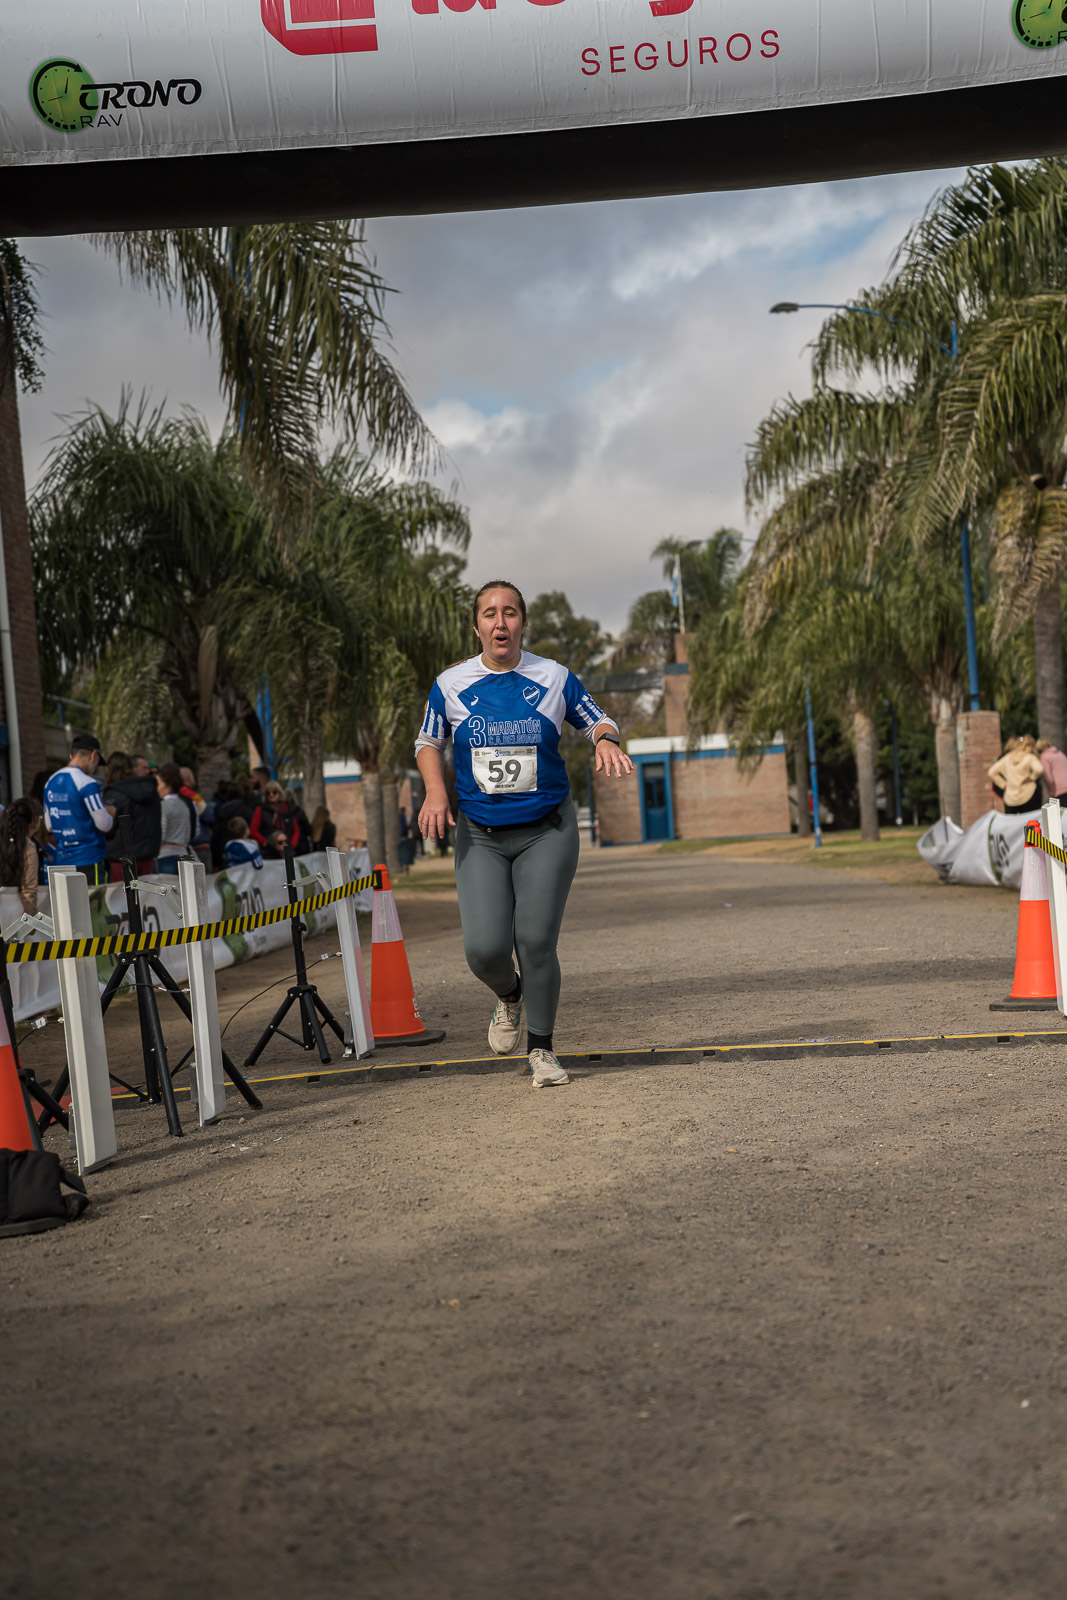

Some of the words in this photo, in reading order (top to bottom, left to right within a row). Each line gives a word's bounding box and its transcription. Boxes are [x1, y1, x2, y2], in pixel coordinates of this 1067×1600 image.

[581, 29, 780, 76] SEGUROS
[79, 78, 202, 111] CRONO
[80, 113, 123, 129] RAV
[468, 715, 487, 749] 3
[487, 717, 542, 736] MARATÓN
[488, 759, 522, 783] 59
